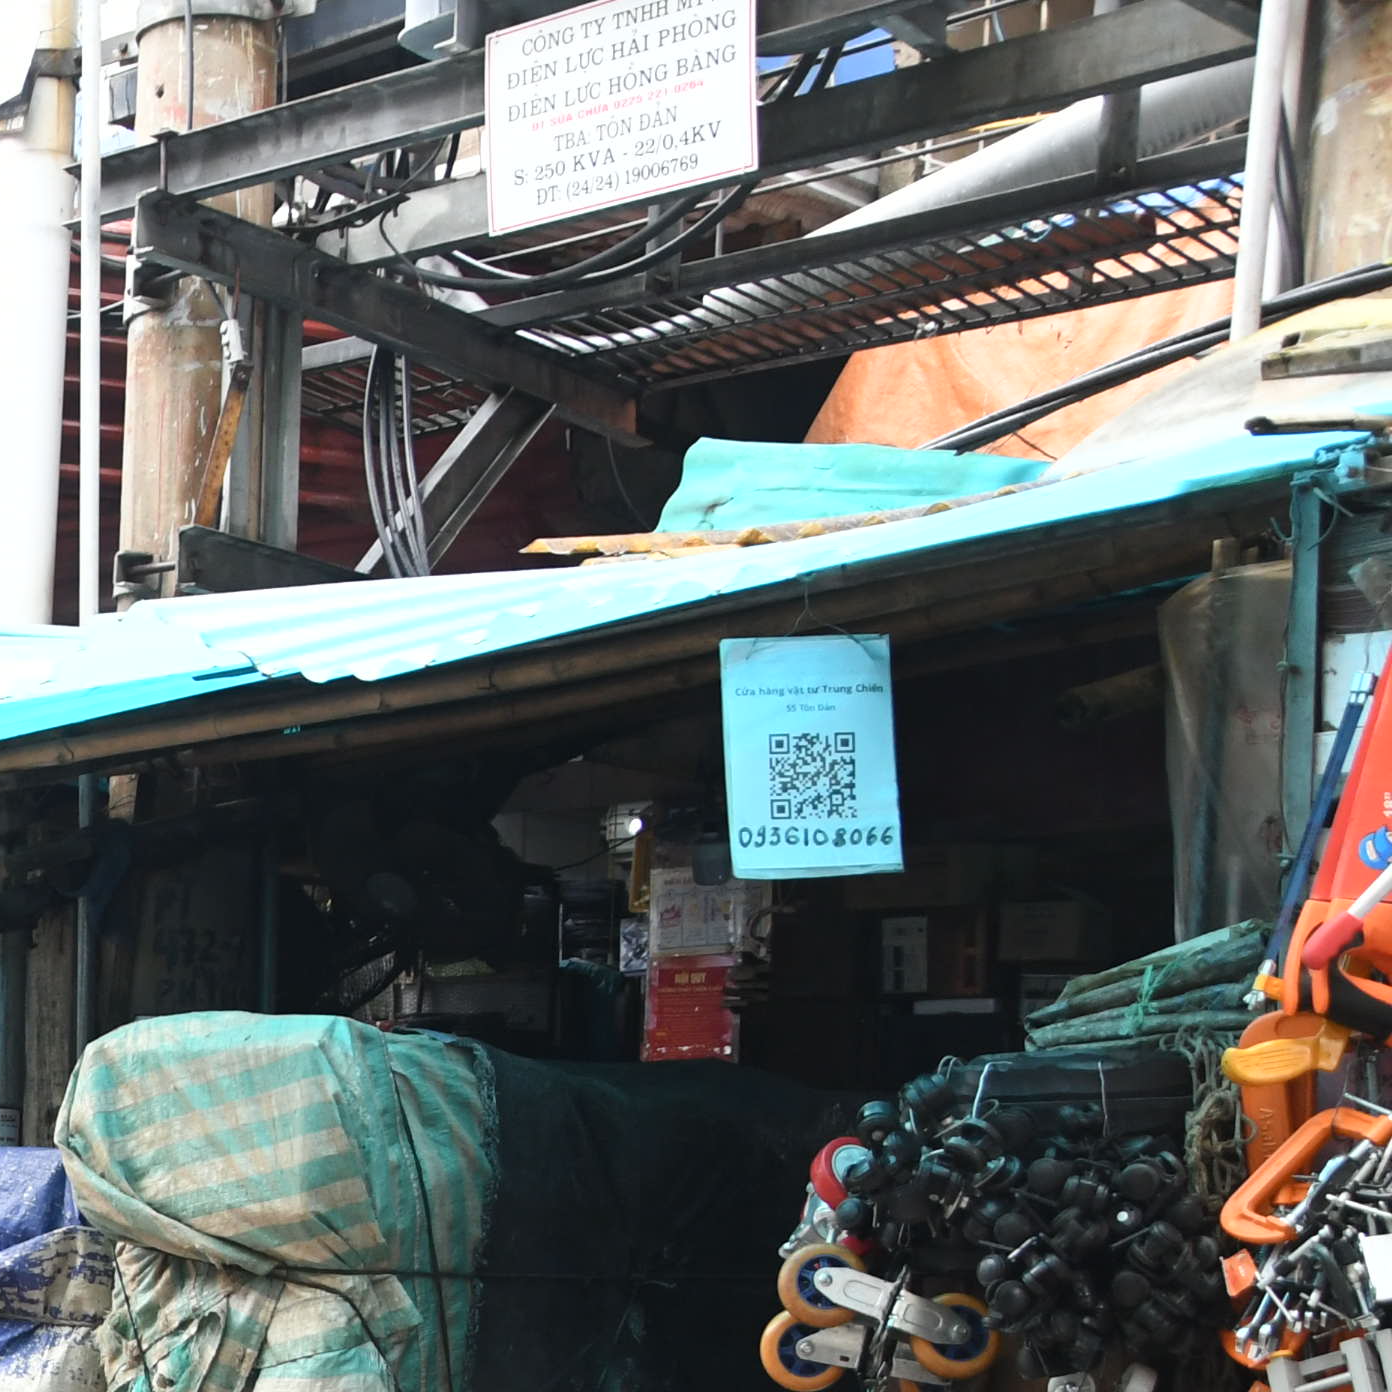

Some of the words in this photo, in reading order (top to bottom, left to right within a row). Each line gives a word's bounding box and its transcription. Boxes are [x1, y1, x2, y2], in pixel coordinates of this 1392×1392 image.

[521, 28, 575, 57] CÔNG
[581, 16, 606, 40] TY
[613, 0, 669, 30] TNHH
[506, 59, 558, 90] ĐIỆN
[564, 47, 605, 74] LỰC
[610, 28, 649, 62] HẢI
[658, 9, 737, 48] PHÒNG
[596, 114, 633, 142] TÔN
[534, 160, 567, 182] 250
[572, 147, 616, 173] KVA
[624, 153, 700, 186] 19006769
[823, 684, 853, 696] Trung
[737, 825, 895, 850] 0936108066
